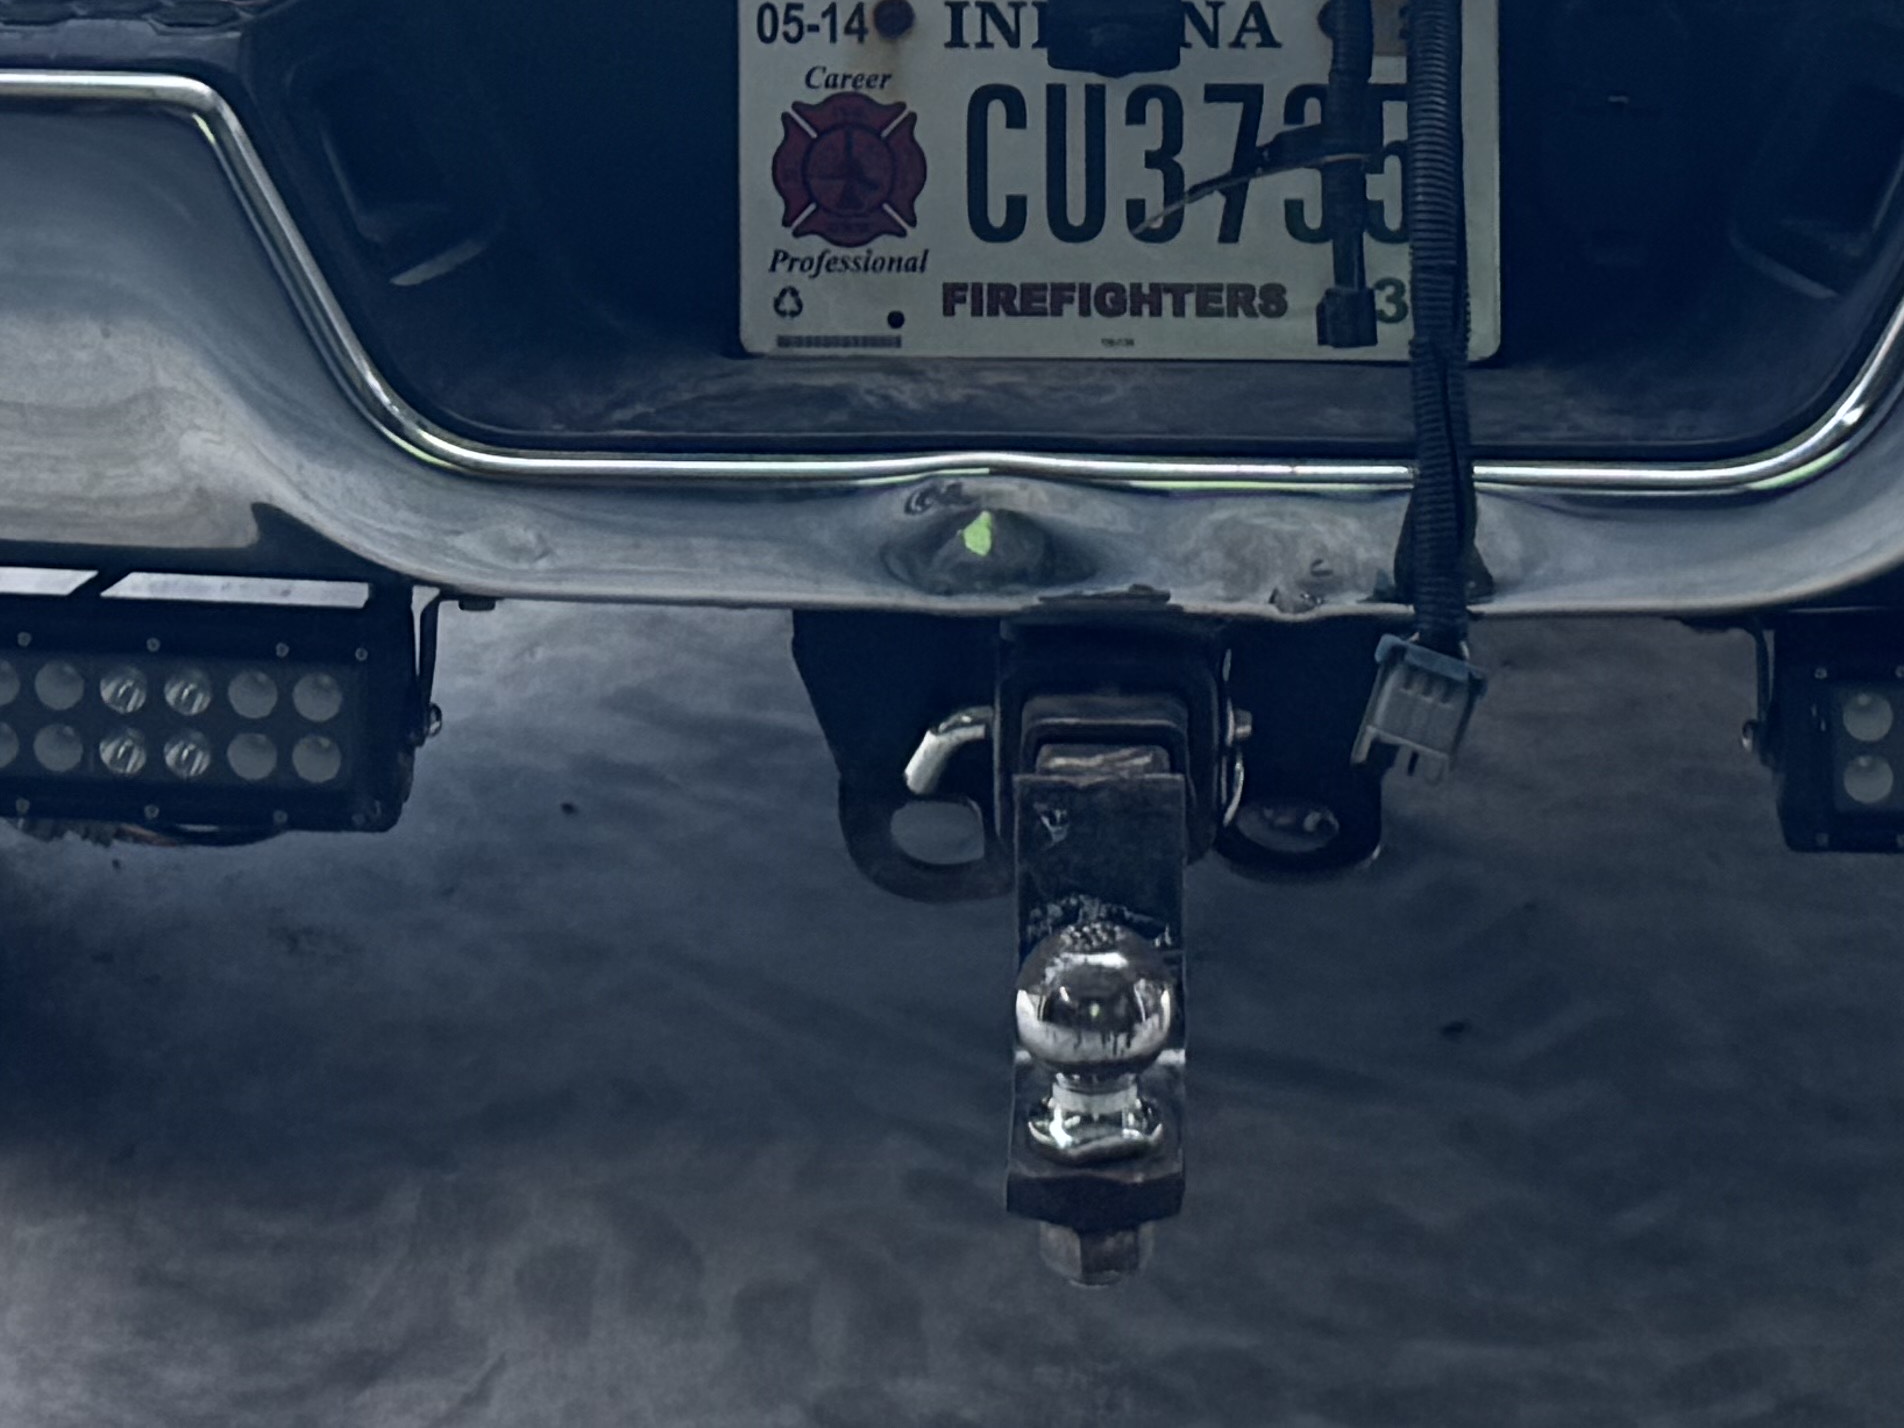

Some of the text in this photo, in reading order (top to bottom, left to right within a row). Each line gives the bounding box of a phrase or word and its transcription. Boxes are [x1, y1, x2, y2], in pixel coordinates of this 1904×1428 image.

[756, 0, 1283, 49] 05-14 INNA
[804, 65, 893, 90] Career
[768, 248, 930, 276] Professional
[942, 281, 1289, 319] FIREFIGHTERS
